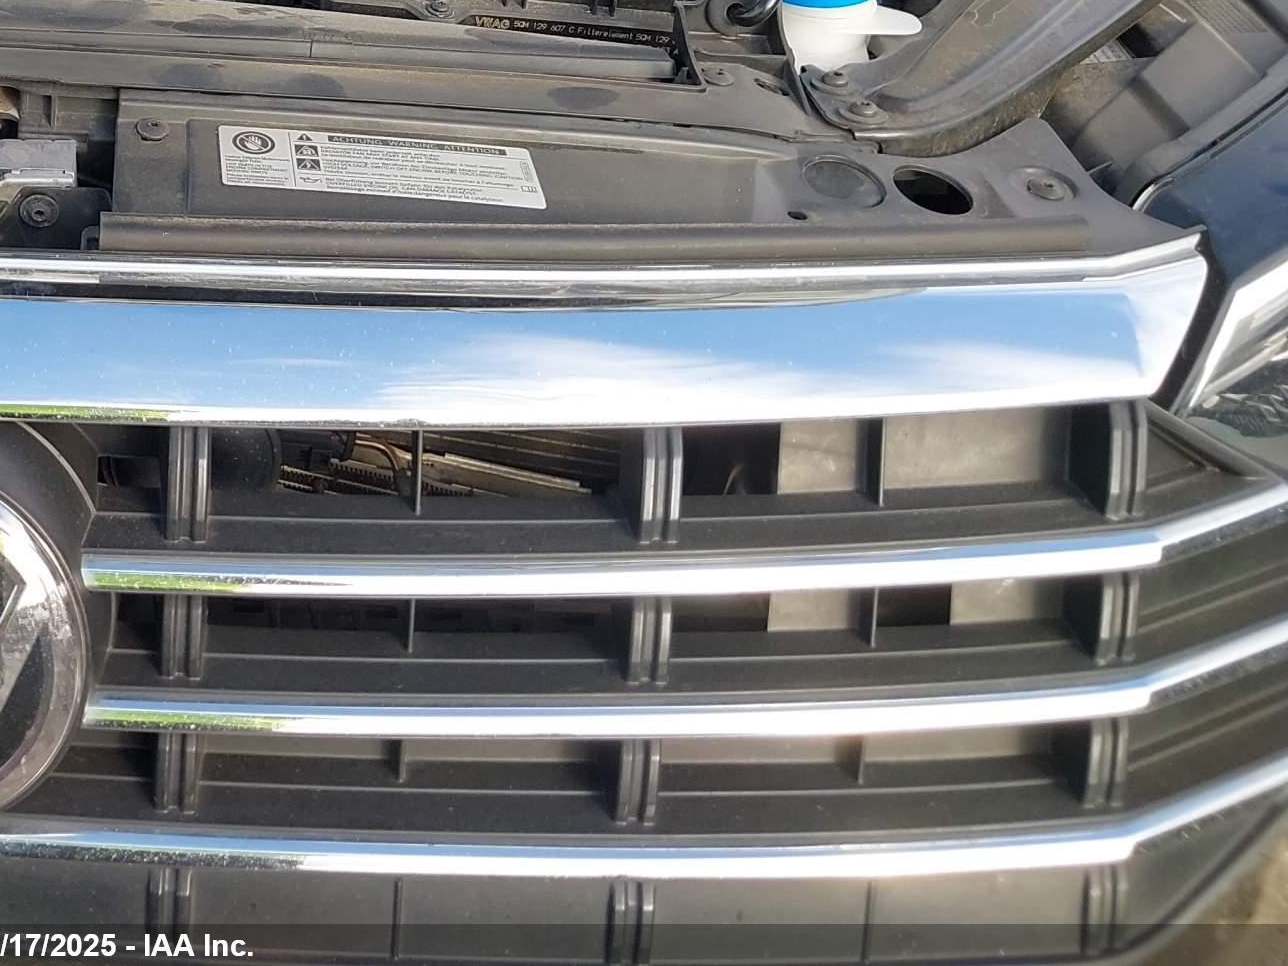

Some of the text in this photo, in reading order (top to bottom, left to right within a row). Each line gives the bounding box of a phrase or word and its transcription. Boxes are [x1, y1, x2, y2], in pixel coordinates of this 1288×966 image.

[533, 22, 548, 31] 129
[655, 35, 670, 44] 129
[332, 136, 500, 155] ACHTUNG WARNING ATTENTION
